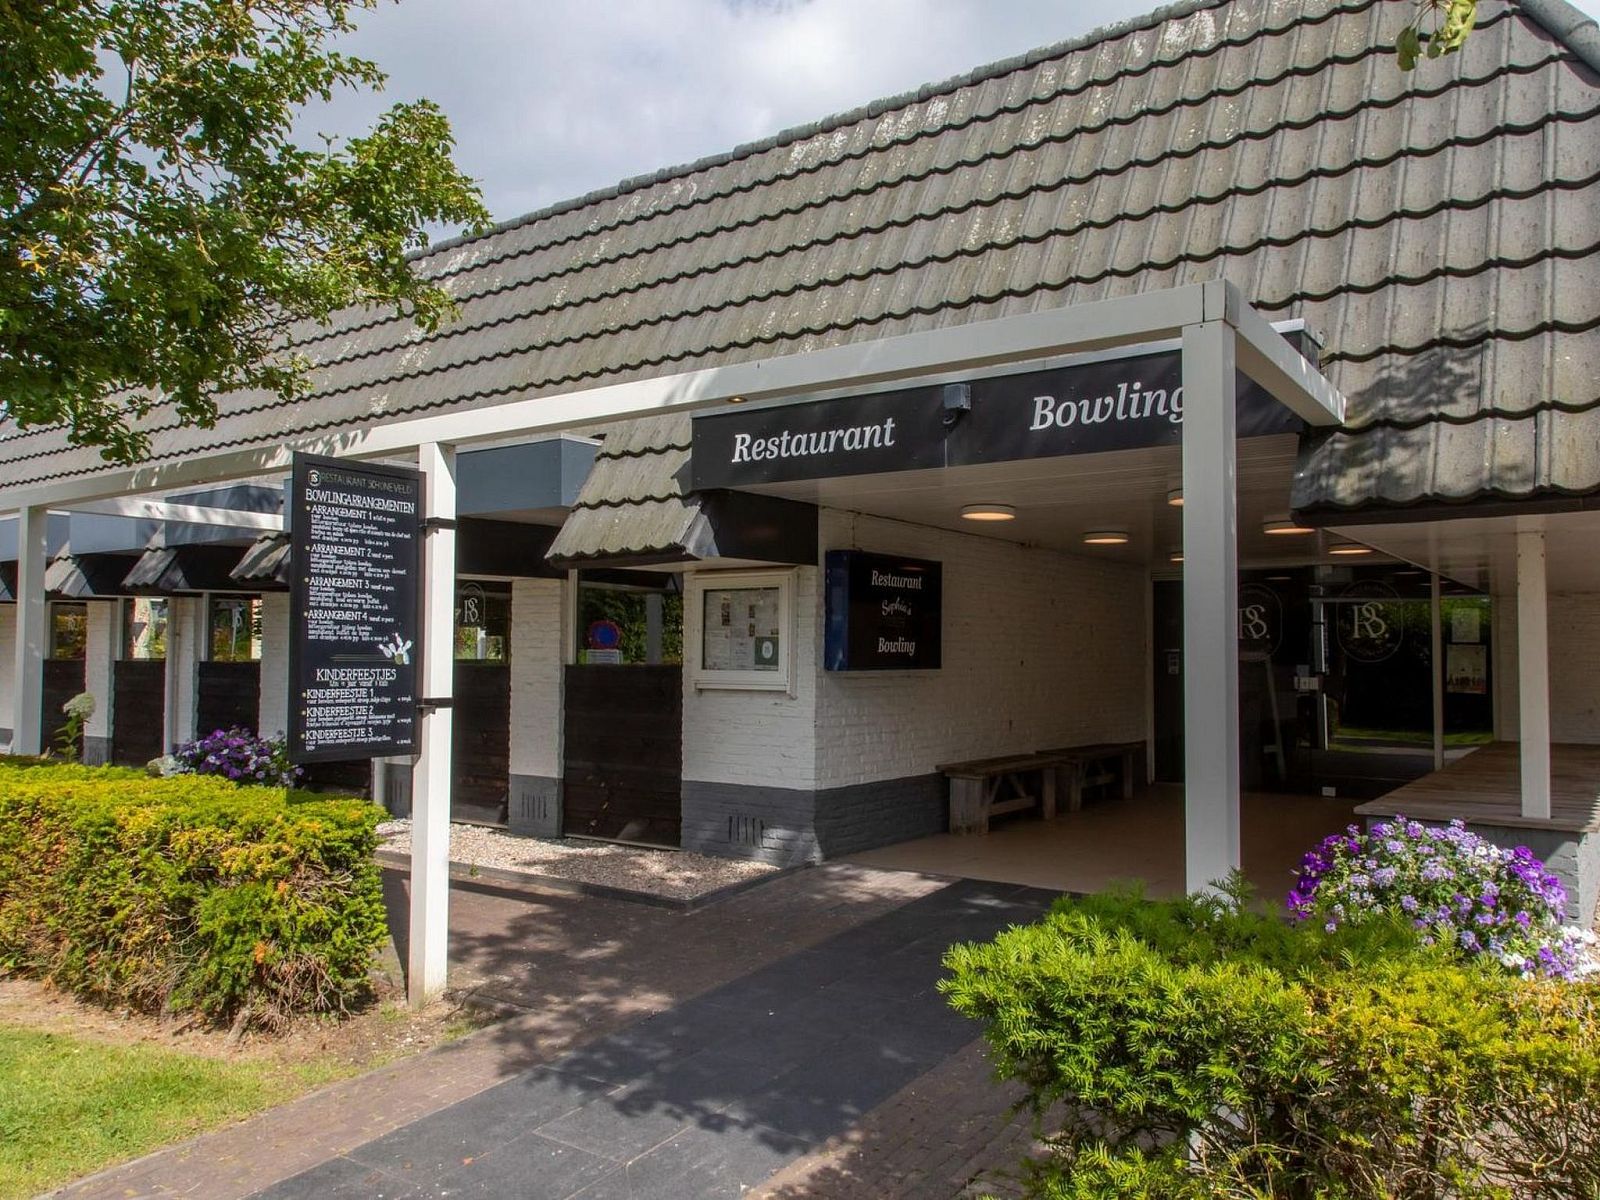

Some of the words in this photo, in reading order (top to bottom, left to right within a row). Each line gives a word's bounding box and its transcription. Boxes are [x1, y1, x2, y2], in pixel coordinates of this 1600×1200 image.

[731, 416, 896, 464] Restaurant
[305, 488, 415, 514] BOWLINGARRANGEMENTEN
[311, 504, 367, 520] ARRANGEMENT
[311, 543, 366, 557] ARRANGEMENT
[366, 548, 372, 557] 2
[309, 576, 363, 589] ARRANGEMENT
[365, 580, 370, 589] 3
[871, 570, 922, 590] Restaurant
[308, 609, 362, 621] ARRANGEMENT
[362, 612, 368, 621] 4
[878, 636, 916, 657] Bowling
[316, 668, 397, 681] KINDERFEESTJES
[306, 688, 368, 699] KINDERFEESTJE
[369, 688, 374, 697] 1
[306, 706, 368, 717] KINDERFEESTJE
[368, 705, 374, 715] 2
[305, 728, 366, 740] KINDERFEESTJE
[367, 727, 373, 737] 3
